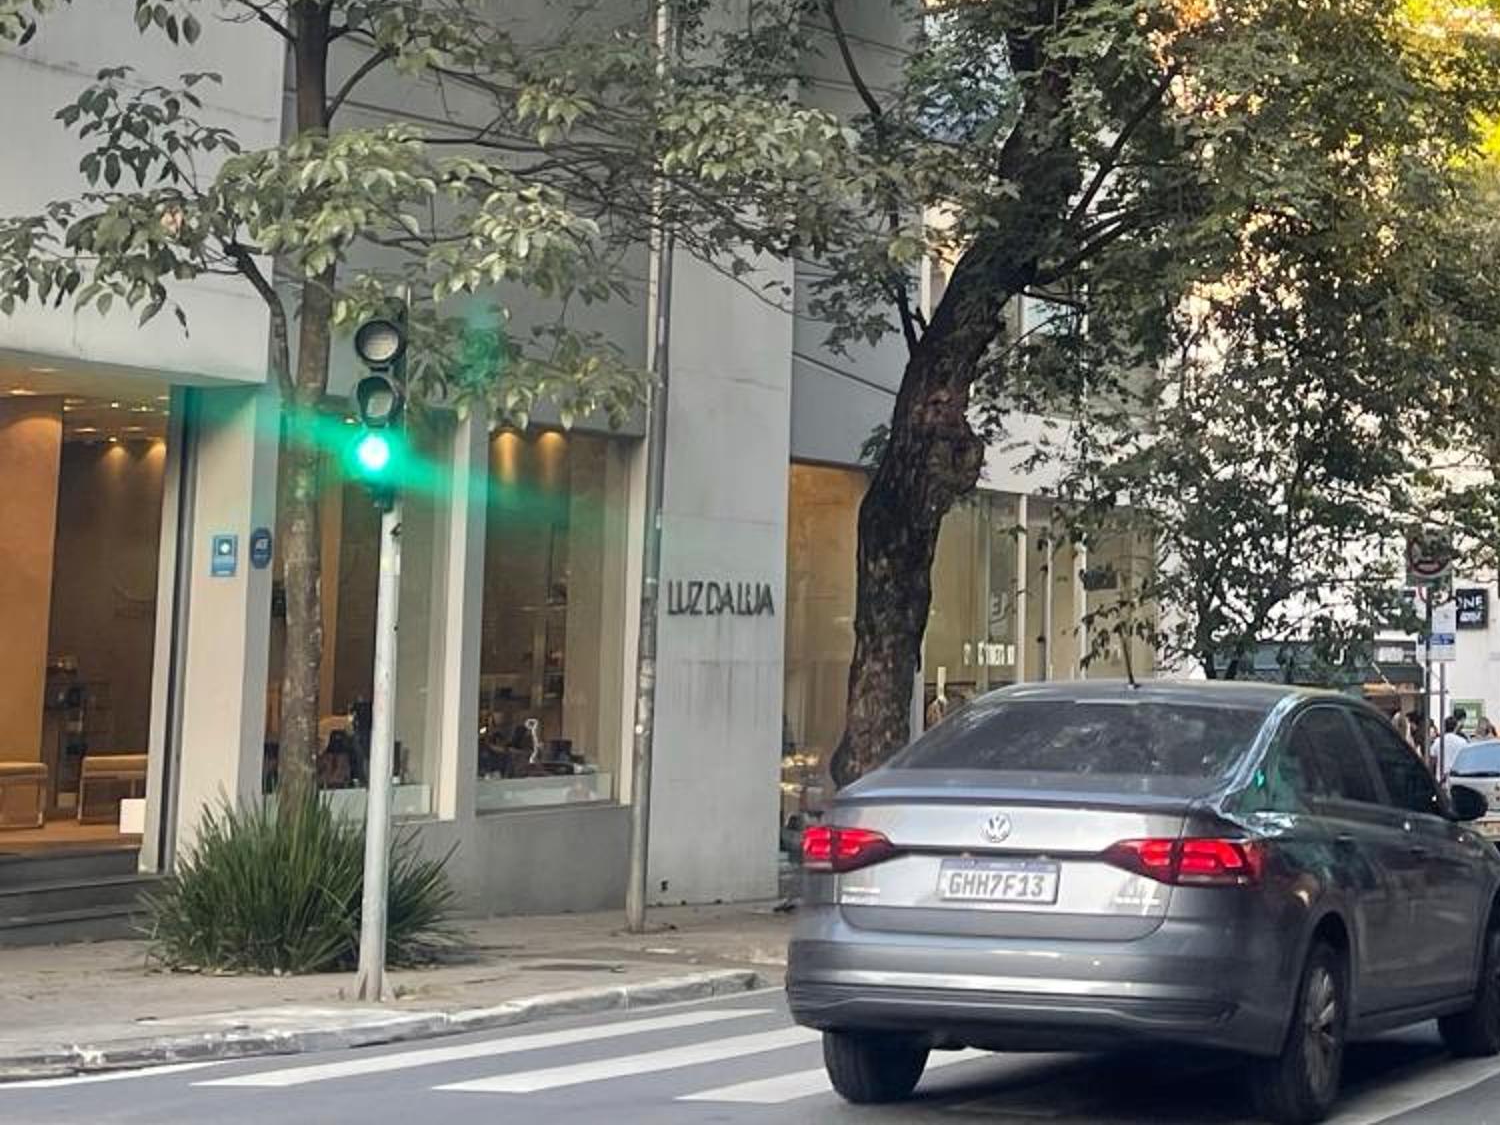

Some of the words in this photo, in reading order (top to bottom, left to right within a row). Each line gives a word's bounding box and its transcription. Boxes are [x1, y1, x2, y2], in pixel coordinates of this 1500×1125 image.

[668, 580, 703, 616] LUZ
[706, 580, 735, 616] DA
[738, 581, 775, 616] LUA
[948, 872, 1045, 897] GHH7F13
